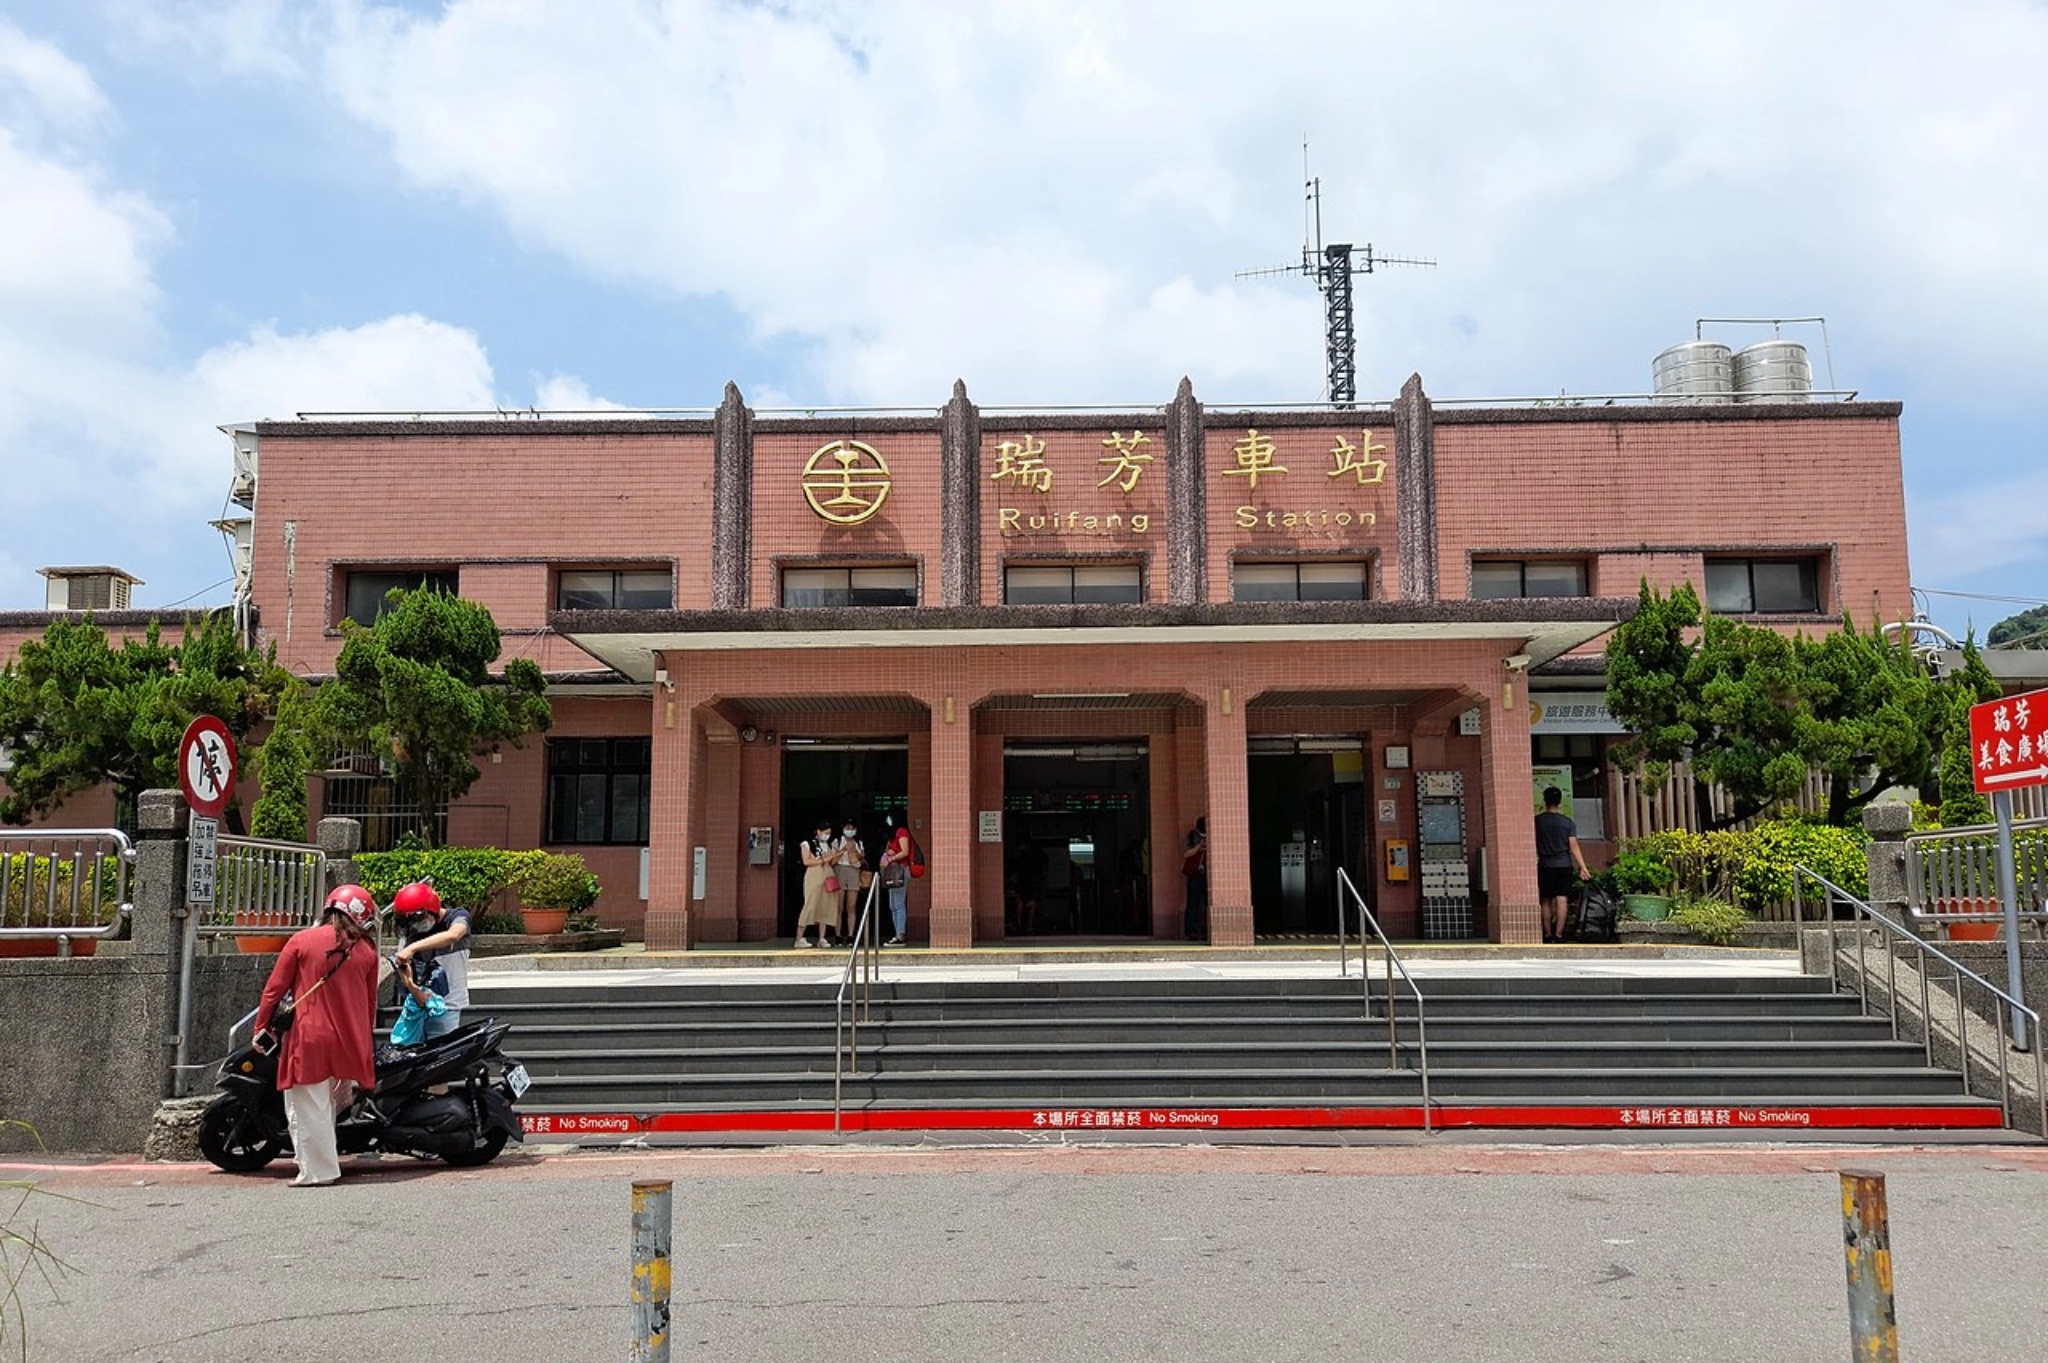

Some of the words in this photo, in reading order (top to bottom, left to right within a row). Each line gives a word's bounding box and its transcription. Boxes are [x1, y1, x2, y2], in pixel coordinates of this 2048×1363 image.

[990, 430, 1154, 493] 瑞芳
[1222, 428, 1387, 489] 車站
[999, 508, 1149, 533] Ruifang
[1235, 505, 1376, 529] Station
[1545, 705, 1607, 718] 旅遊服務中
[1993, 698, 2031, 732] 瑞芳
[559, 1118, 576, 1129] No
[579, 1117, 629, 1132] Smoking
[1033, 1111, 1141, 1126] 本場所全面禁菸
[1150, 1113, 1166, 1123] No
[1169, 1111, 1219, 1125] Smoking
[1620, 1109, 1731, 1125] 本場所全面禁菸
[1738, 1111, 1755, 1122] No
[1759, 1110, 1810, 1124] Smoking
